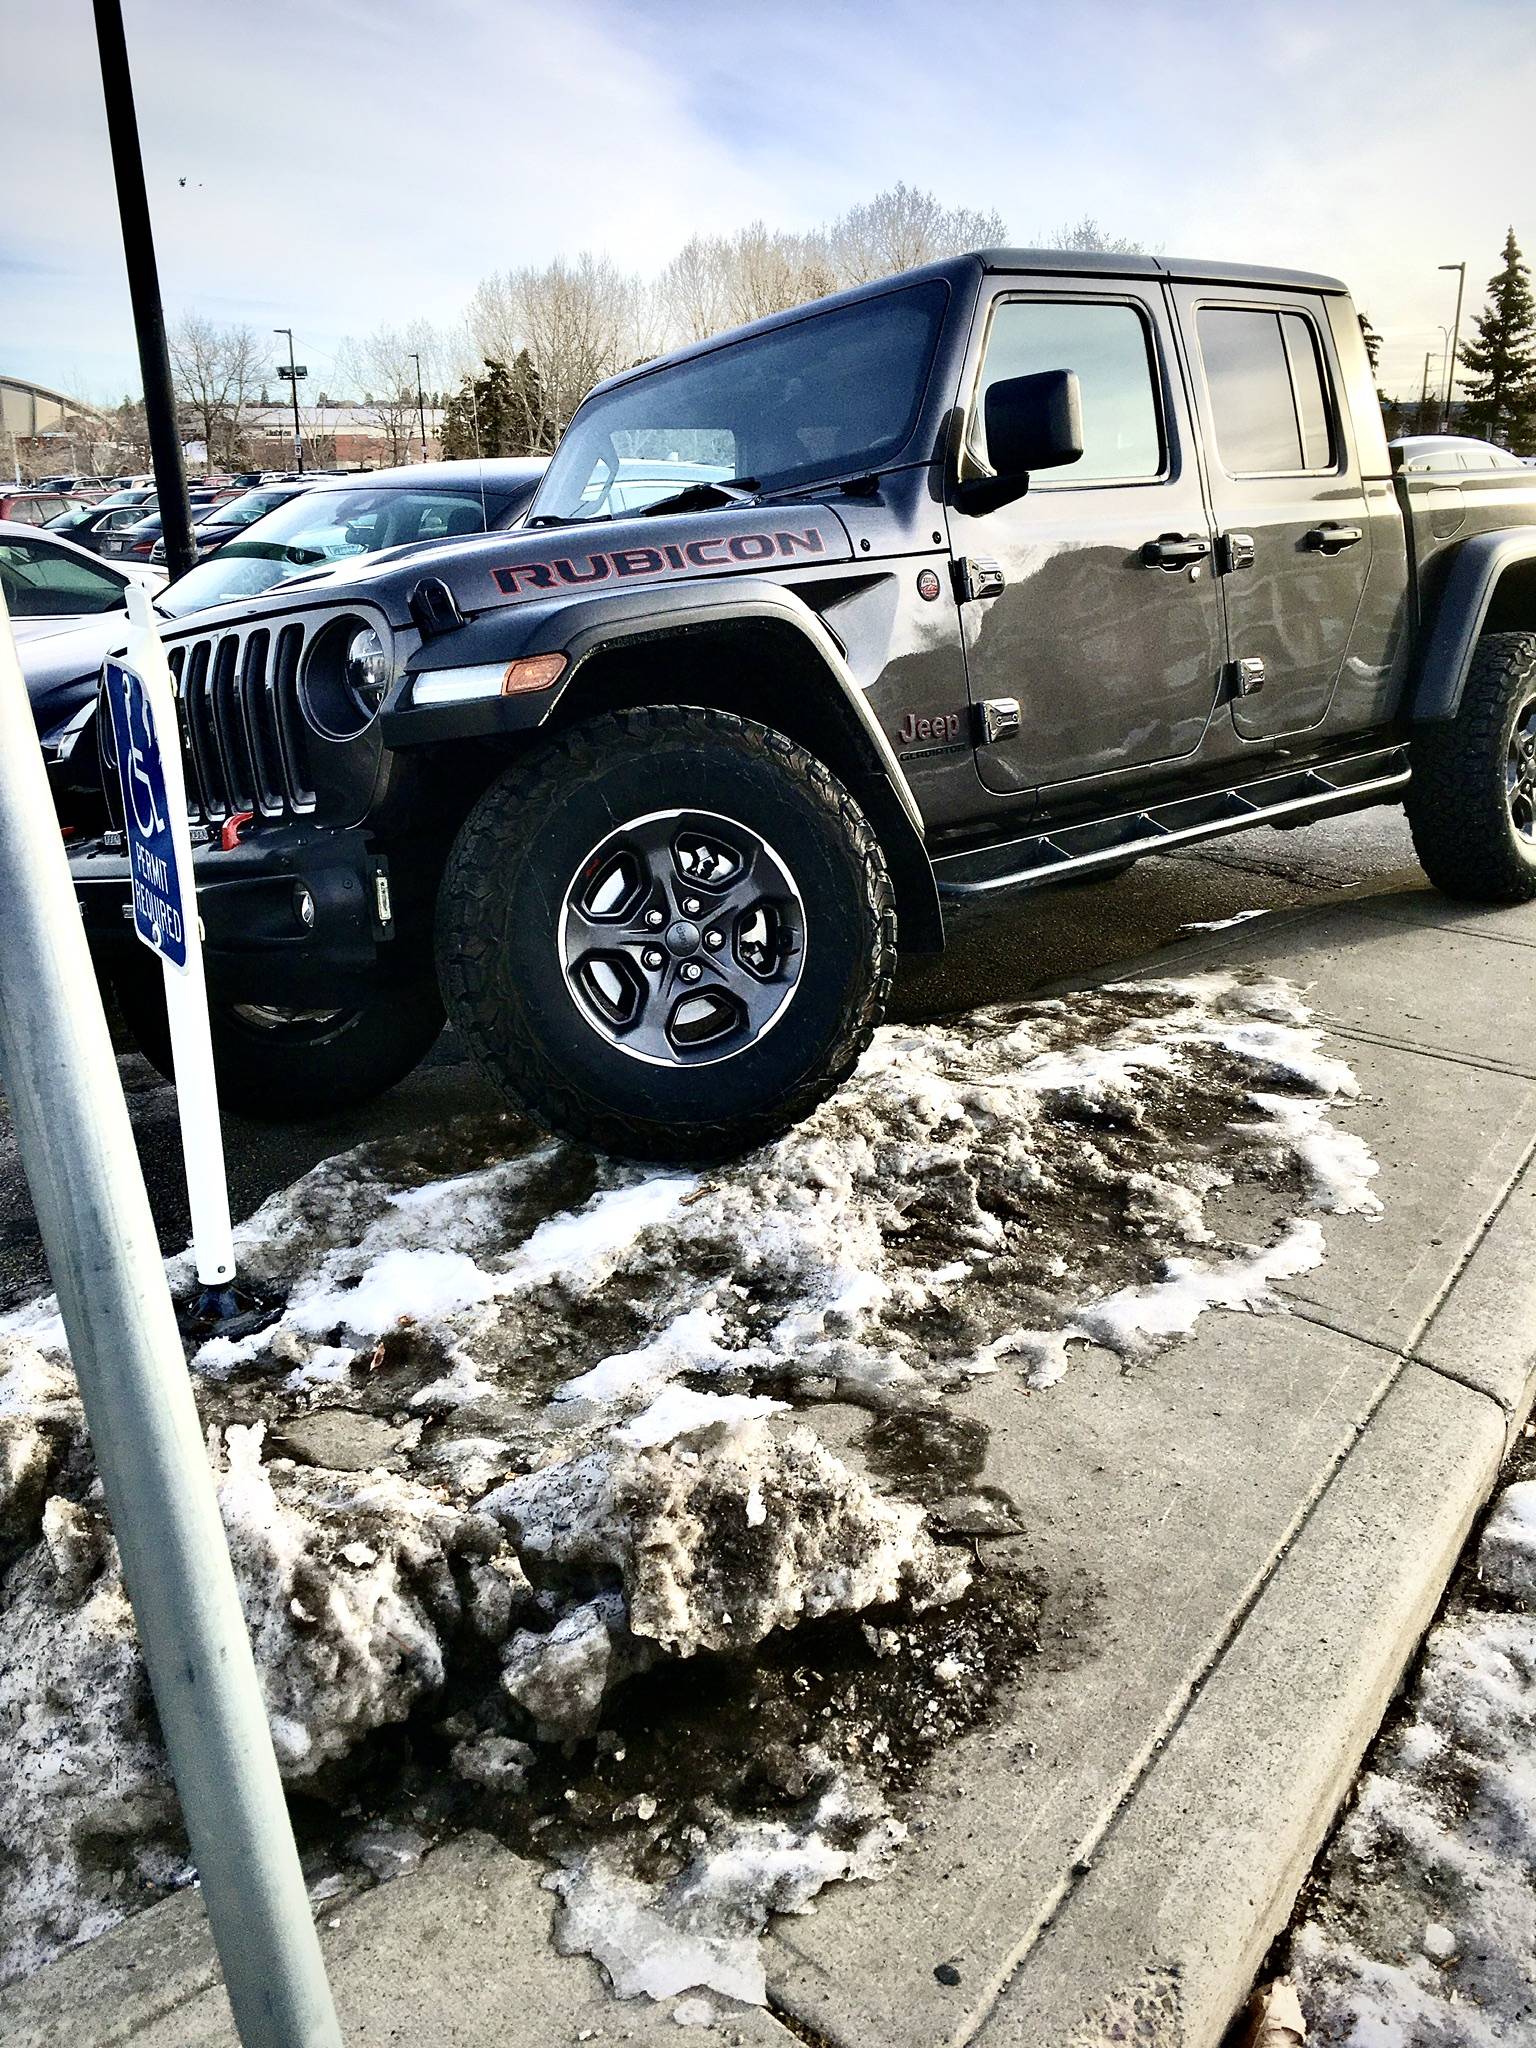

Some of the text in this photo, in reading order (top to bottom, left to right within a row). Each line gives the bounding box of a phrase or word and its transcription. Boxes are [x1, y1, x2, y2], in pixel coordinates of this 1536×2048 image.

[490, 528, 826, 595] RUBICON
[898, 713, 960, 743] Jeep
[135, 841, 169, 894] PERMIT
[134, 879, 182, 942] REQUIRED
